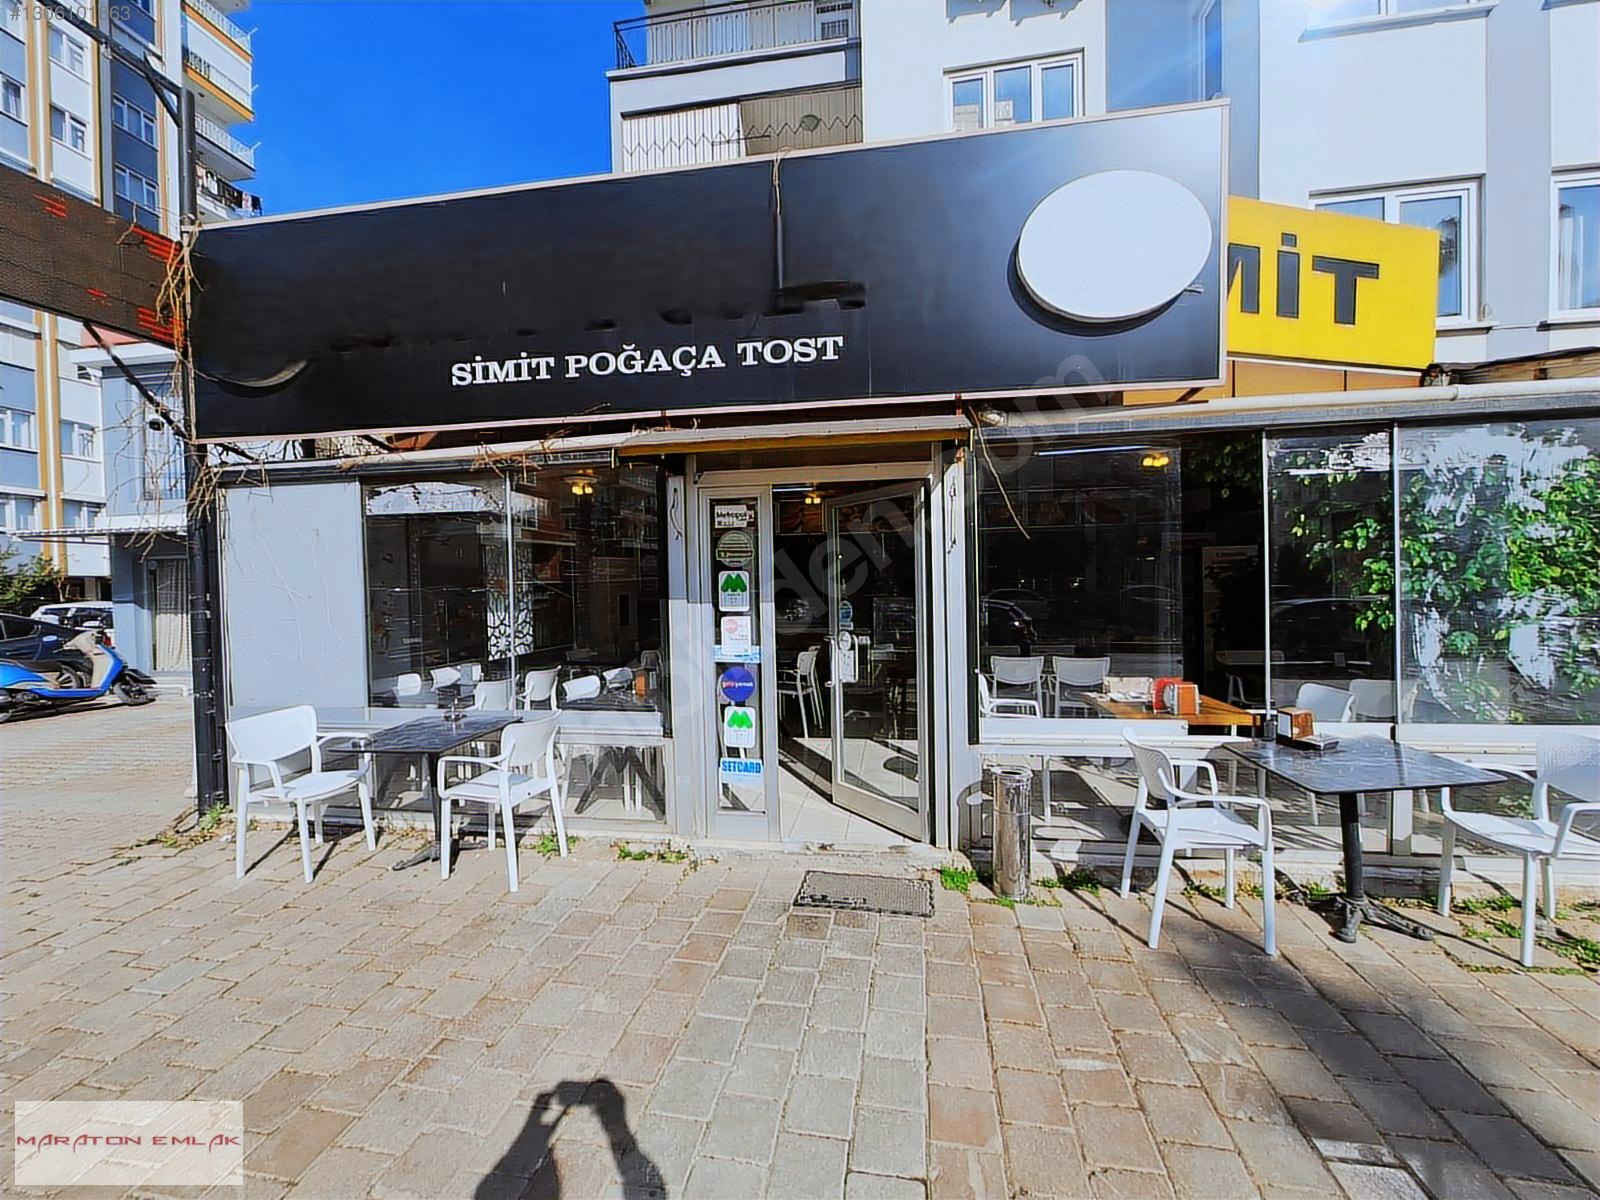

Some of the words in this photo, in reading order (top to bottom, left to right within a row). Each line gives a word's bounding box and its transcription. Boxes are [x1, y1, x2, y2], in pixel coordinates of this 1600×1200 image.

[451, 351, 555, 387] SİMİT
[564, 343, 726, 377] POĞAÇA
[736, 335, 844, 367] TOST
[721, 760, 761, 773] SETCARD
